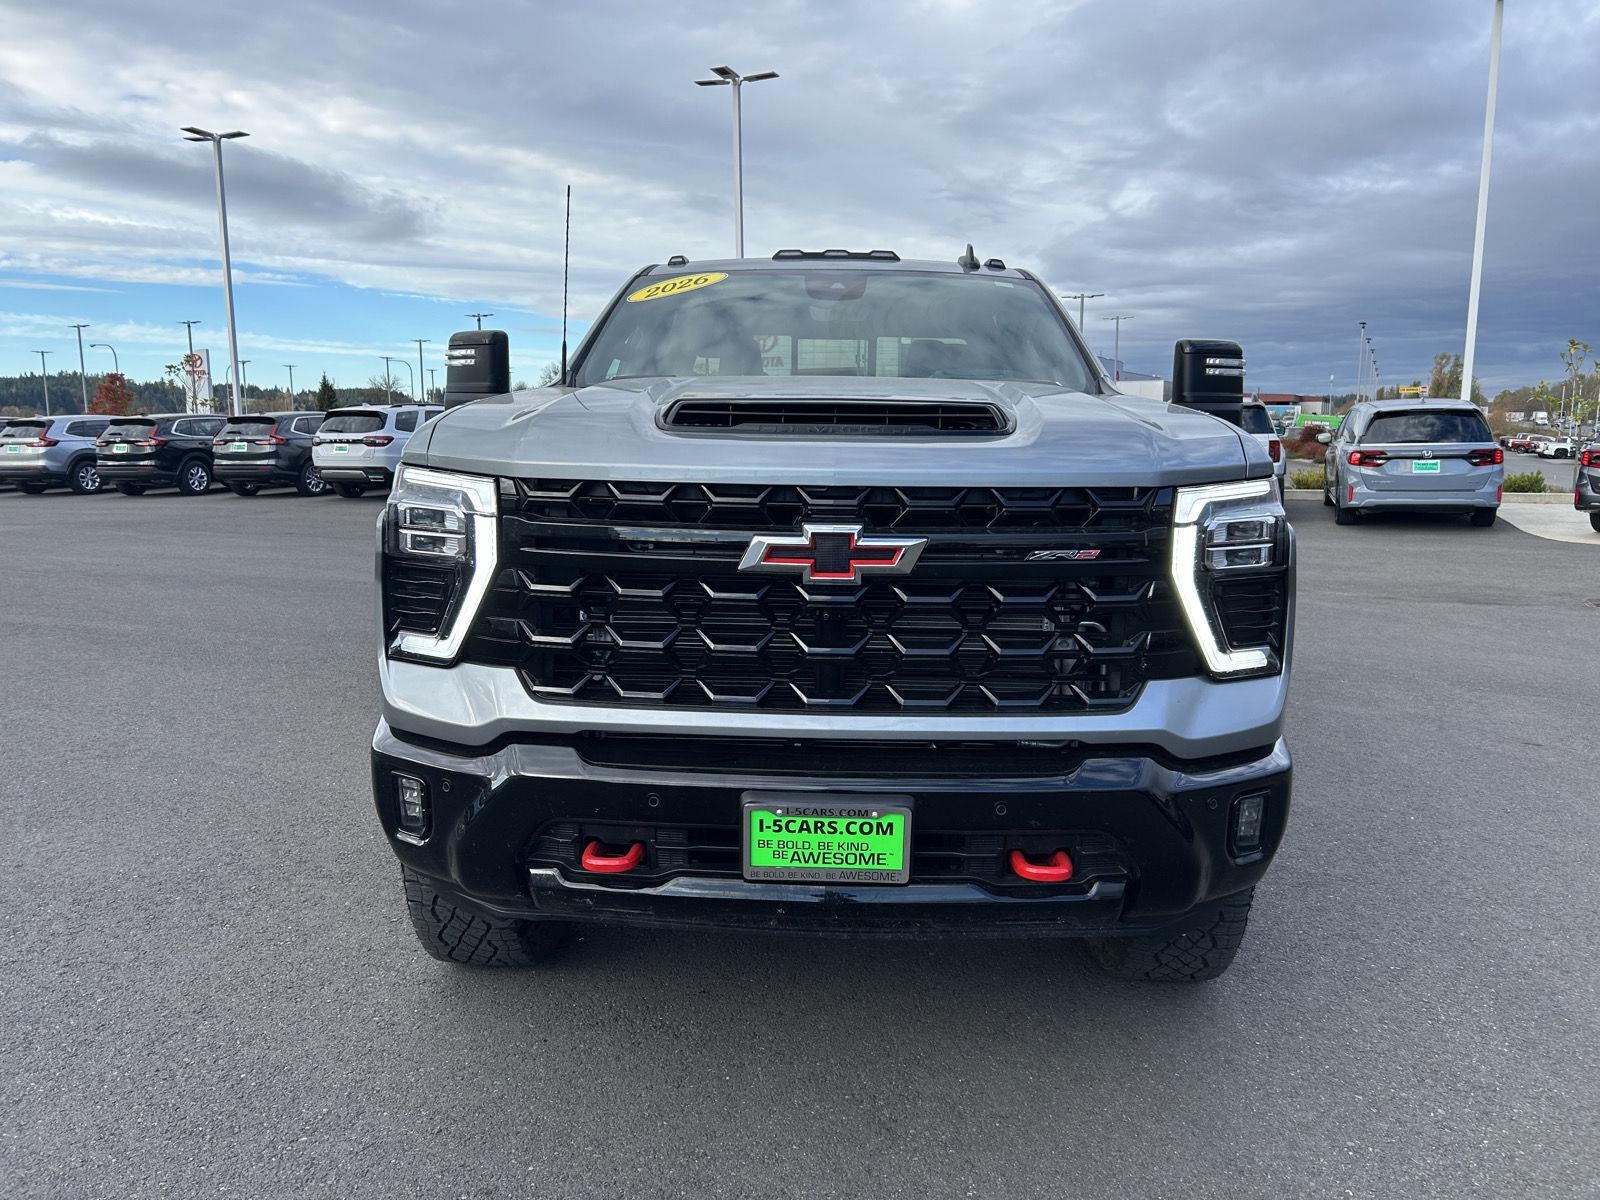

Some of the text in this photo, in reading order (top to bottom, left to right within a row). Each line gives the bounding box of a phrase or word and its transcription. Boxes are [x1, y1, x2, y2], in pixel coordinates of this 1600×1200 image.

[644, 275, 709, 299] 2026
[786, 807, 869, 818] I-5CARS.COM
[758, 818, 894, 836] I-5CARS.COM
[757, 839, 872, 852] BE BOLD. BE KIND.
[772, 850, 788, 859] BE
[826, 872, 836, 880] BE
